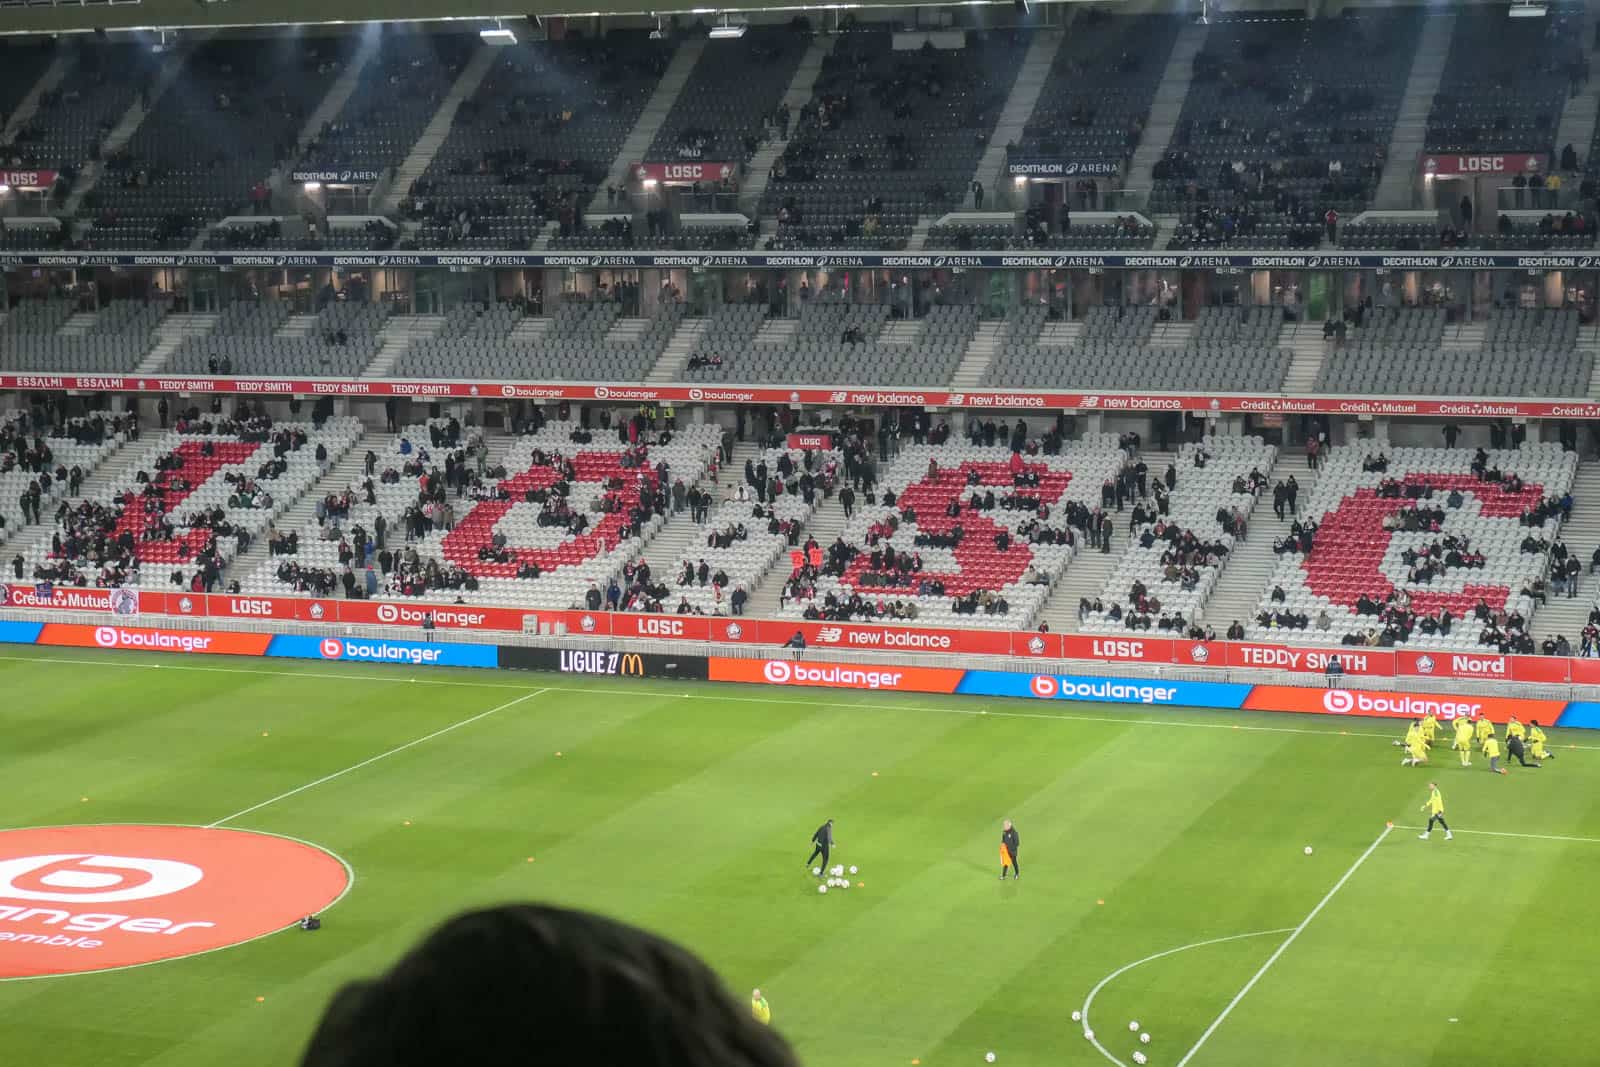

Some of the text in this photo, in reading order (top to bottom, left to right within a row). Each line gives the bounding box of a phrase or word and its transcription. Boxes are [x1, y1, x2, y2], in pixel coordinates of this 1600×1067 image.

[1009, 163, 1117, 173] DECATHLON ARENA
[1458, 156, 1504, 171] LOSC
[293, 171, 383, 180] DECATHLON AREN
[664, 165, 703, 178] LOSC
[3, 172, 38, 185] LOSC
[334, 257, 420, 265] DECATHLON ARENA
[438, 257, 526, 265] DECATHLON ARENA
[544, 257, 635, 265] DECATHLON ARENA
[654, 257, 747, 265] DECATHLON ARENA
[767, 257, 863, 265] DECATHLON ARENA
[883, 257, 982, 265] DECATHLON ARENA
[1002, 257, 1104, 266] DECATHLON ARENA
[1125, 257, 1230, 266] DECATHLON ARENA
[1252, 257, 1360, 266] DECATHLON ARENA
[1383, 257, 1495, 266] DECATHLON ARENA
[1519, 257, 1575, 266] DECATHLON
[159, 381, 214, 391] TEDDY SMITH
[236, 382, 292, 392] TEDDY SMITH
[312, 383, 369, 393] TEDDY SMITH
[391, 384, 450, 394] TEDDY SMITH
[516, 387, 564, 398] boulanger
[610, 387, 657, 399] boulanger
[704, 389, 753, 401] boulanger
[852, 394, 875, 403] new
[969, 396, 993, 405] new
[1104, 398, 1127, 408] new
[1282, 402, 1315, 410] Mutuel
[1382, 403, 1416, 412] Mutuel
[1481, 404, 1517, 414] Mutuel
[800, 438, 821, 446] LOSC
[231, 600, 272, 615] LOSC
[638, 618, 683, 635] LOSC
[121, 630, 212, 651] boulanger
[849, 630, 881, 645] new
[884, 630, 951, 648] balance
[346, 641, 442, 663] boulanger
[1093, 640, 1143, 657] LOSC
[560, 650, 605, 673] LIGUE
[1241, 648, 1301, 667] TEDDY
[1453, 655, 1505, 673] Nord
[794, 665, 902, 687] boulanger
[1062, 679, 1177, 704] boulanger
[1358, 693, 1481, 720] boulanger
